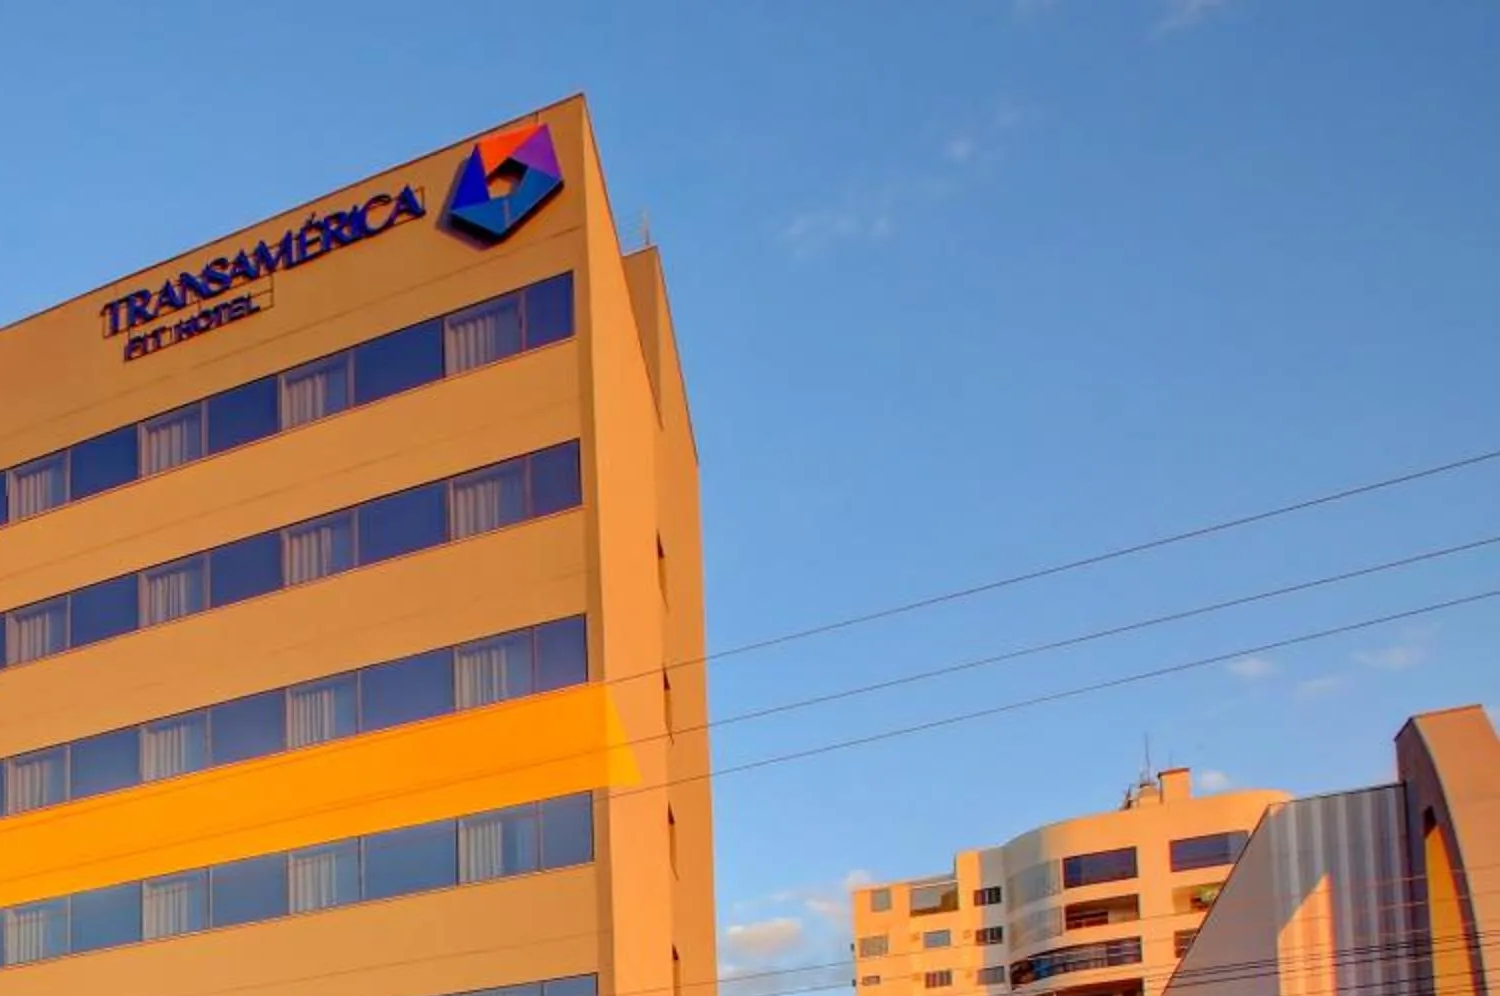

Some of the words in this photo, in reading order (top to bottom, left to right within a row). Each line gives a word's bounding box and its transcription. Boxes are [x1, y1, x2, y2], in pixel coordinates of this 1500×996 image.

[100, 184, 426, 336] TRANSAMÉRICA
[125, 327, 167, 361] FIT
[174, 294, 260, 342] HOTEL
